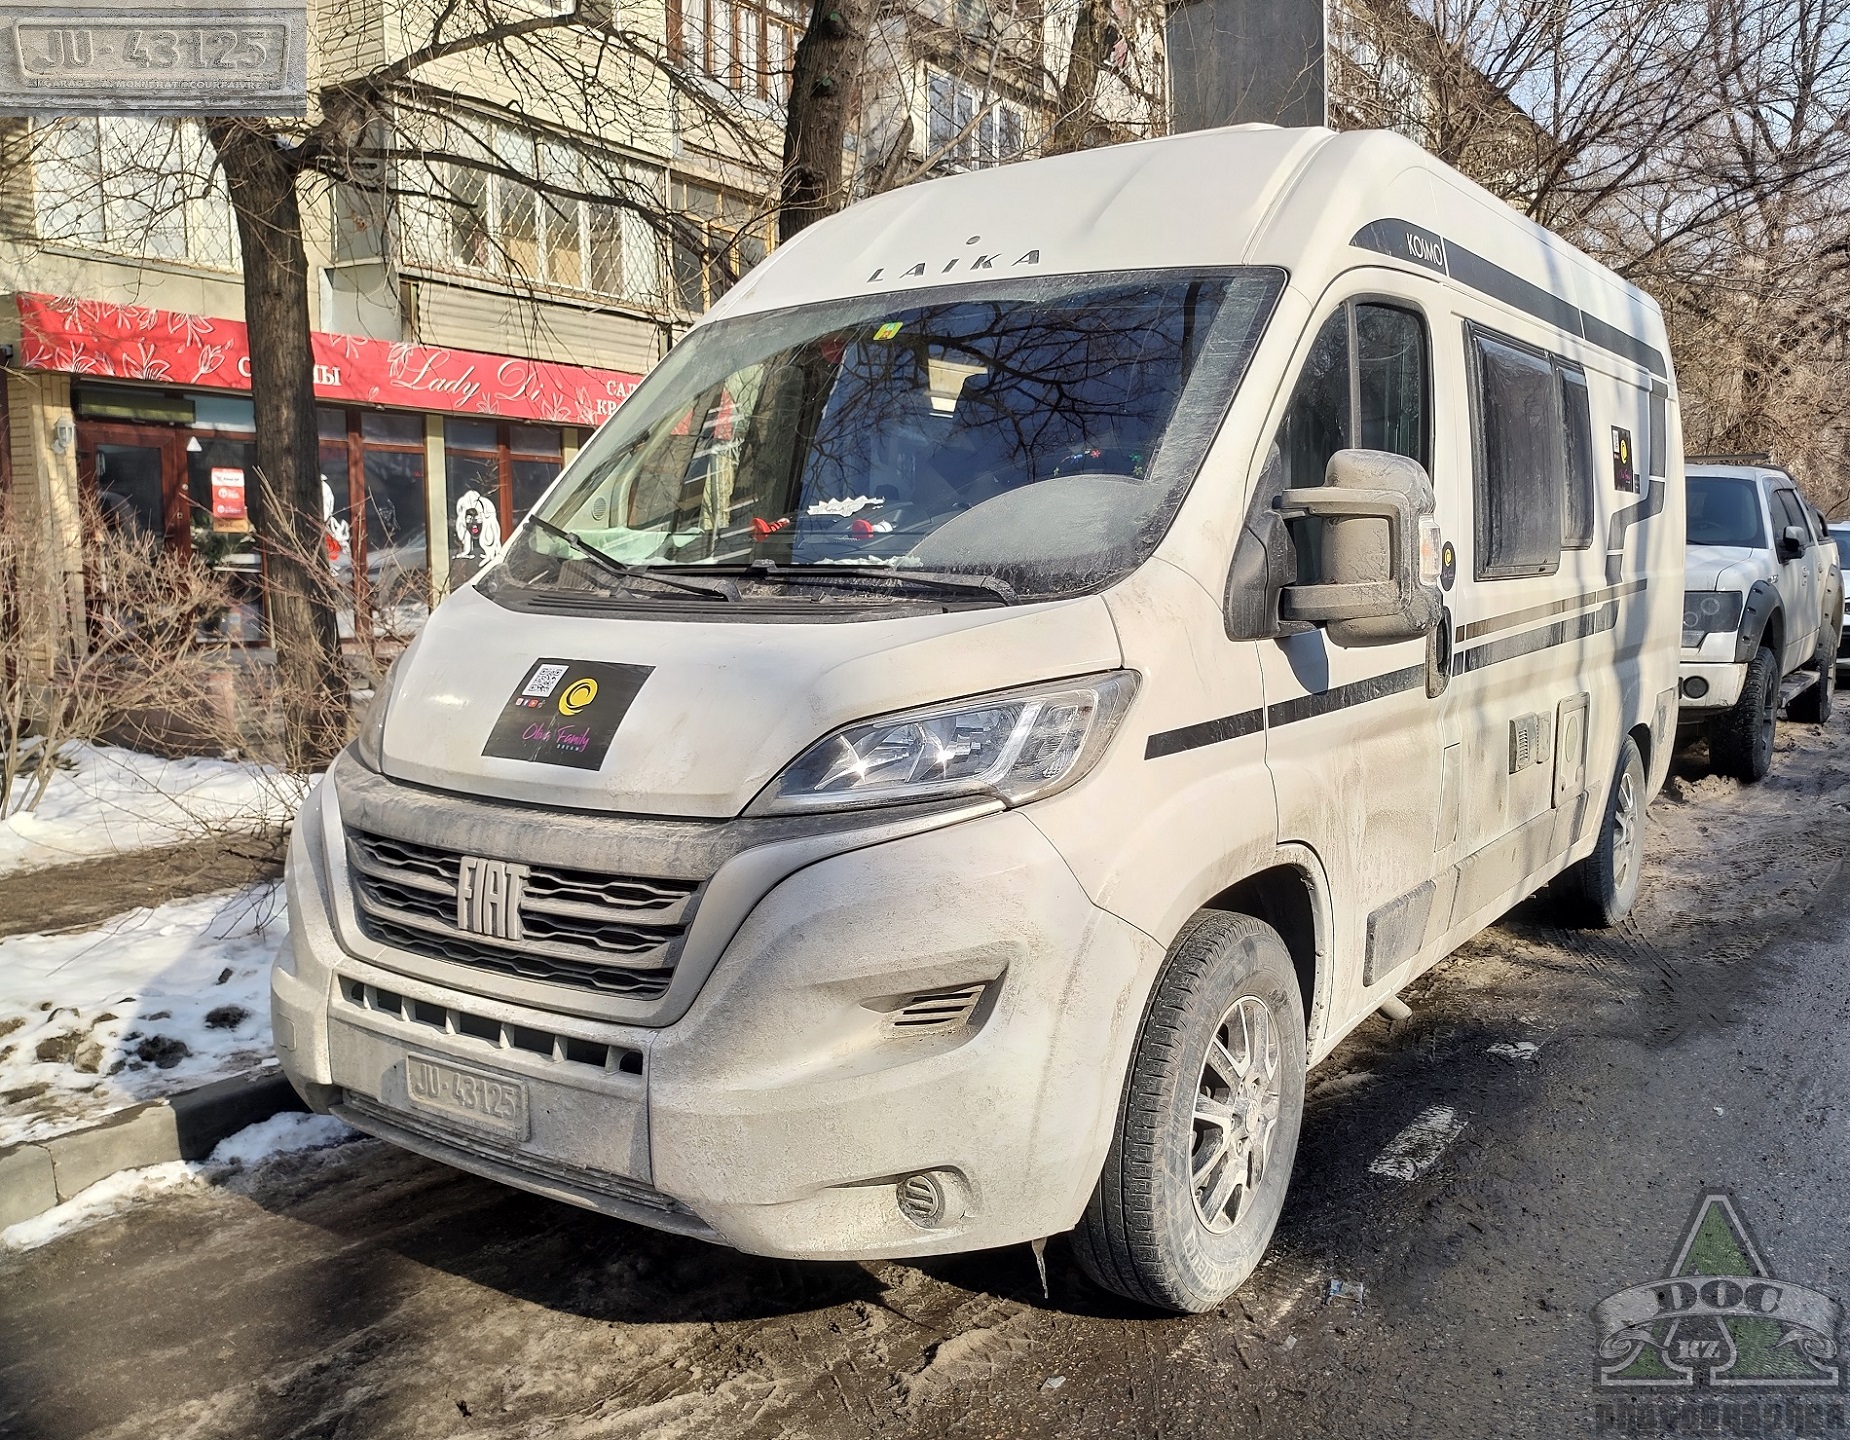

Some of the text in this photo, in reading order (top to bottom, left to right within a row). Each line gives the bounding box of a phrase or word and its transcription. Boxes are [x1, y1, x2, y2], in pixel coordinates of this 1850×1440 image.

[866, 249, 1041, 283] LAIKA
[390, 348, 481, 408] Lady
[494, 358, 545, 402] Di
[457, 855, 531, 941] FIAT
[414, 1062, 441, 1099] JU
[452, 1072, 517, 1121] 43125
